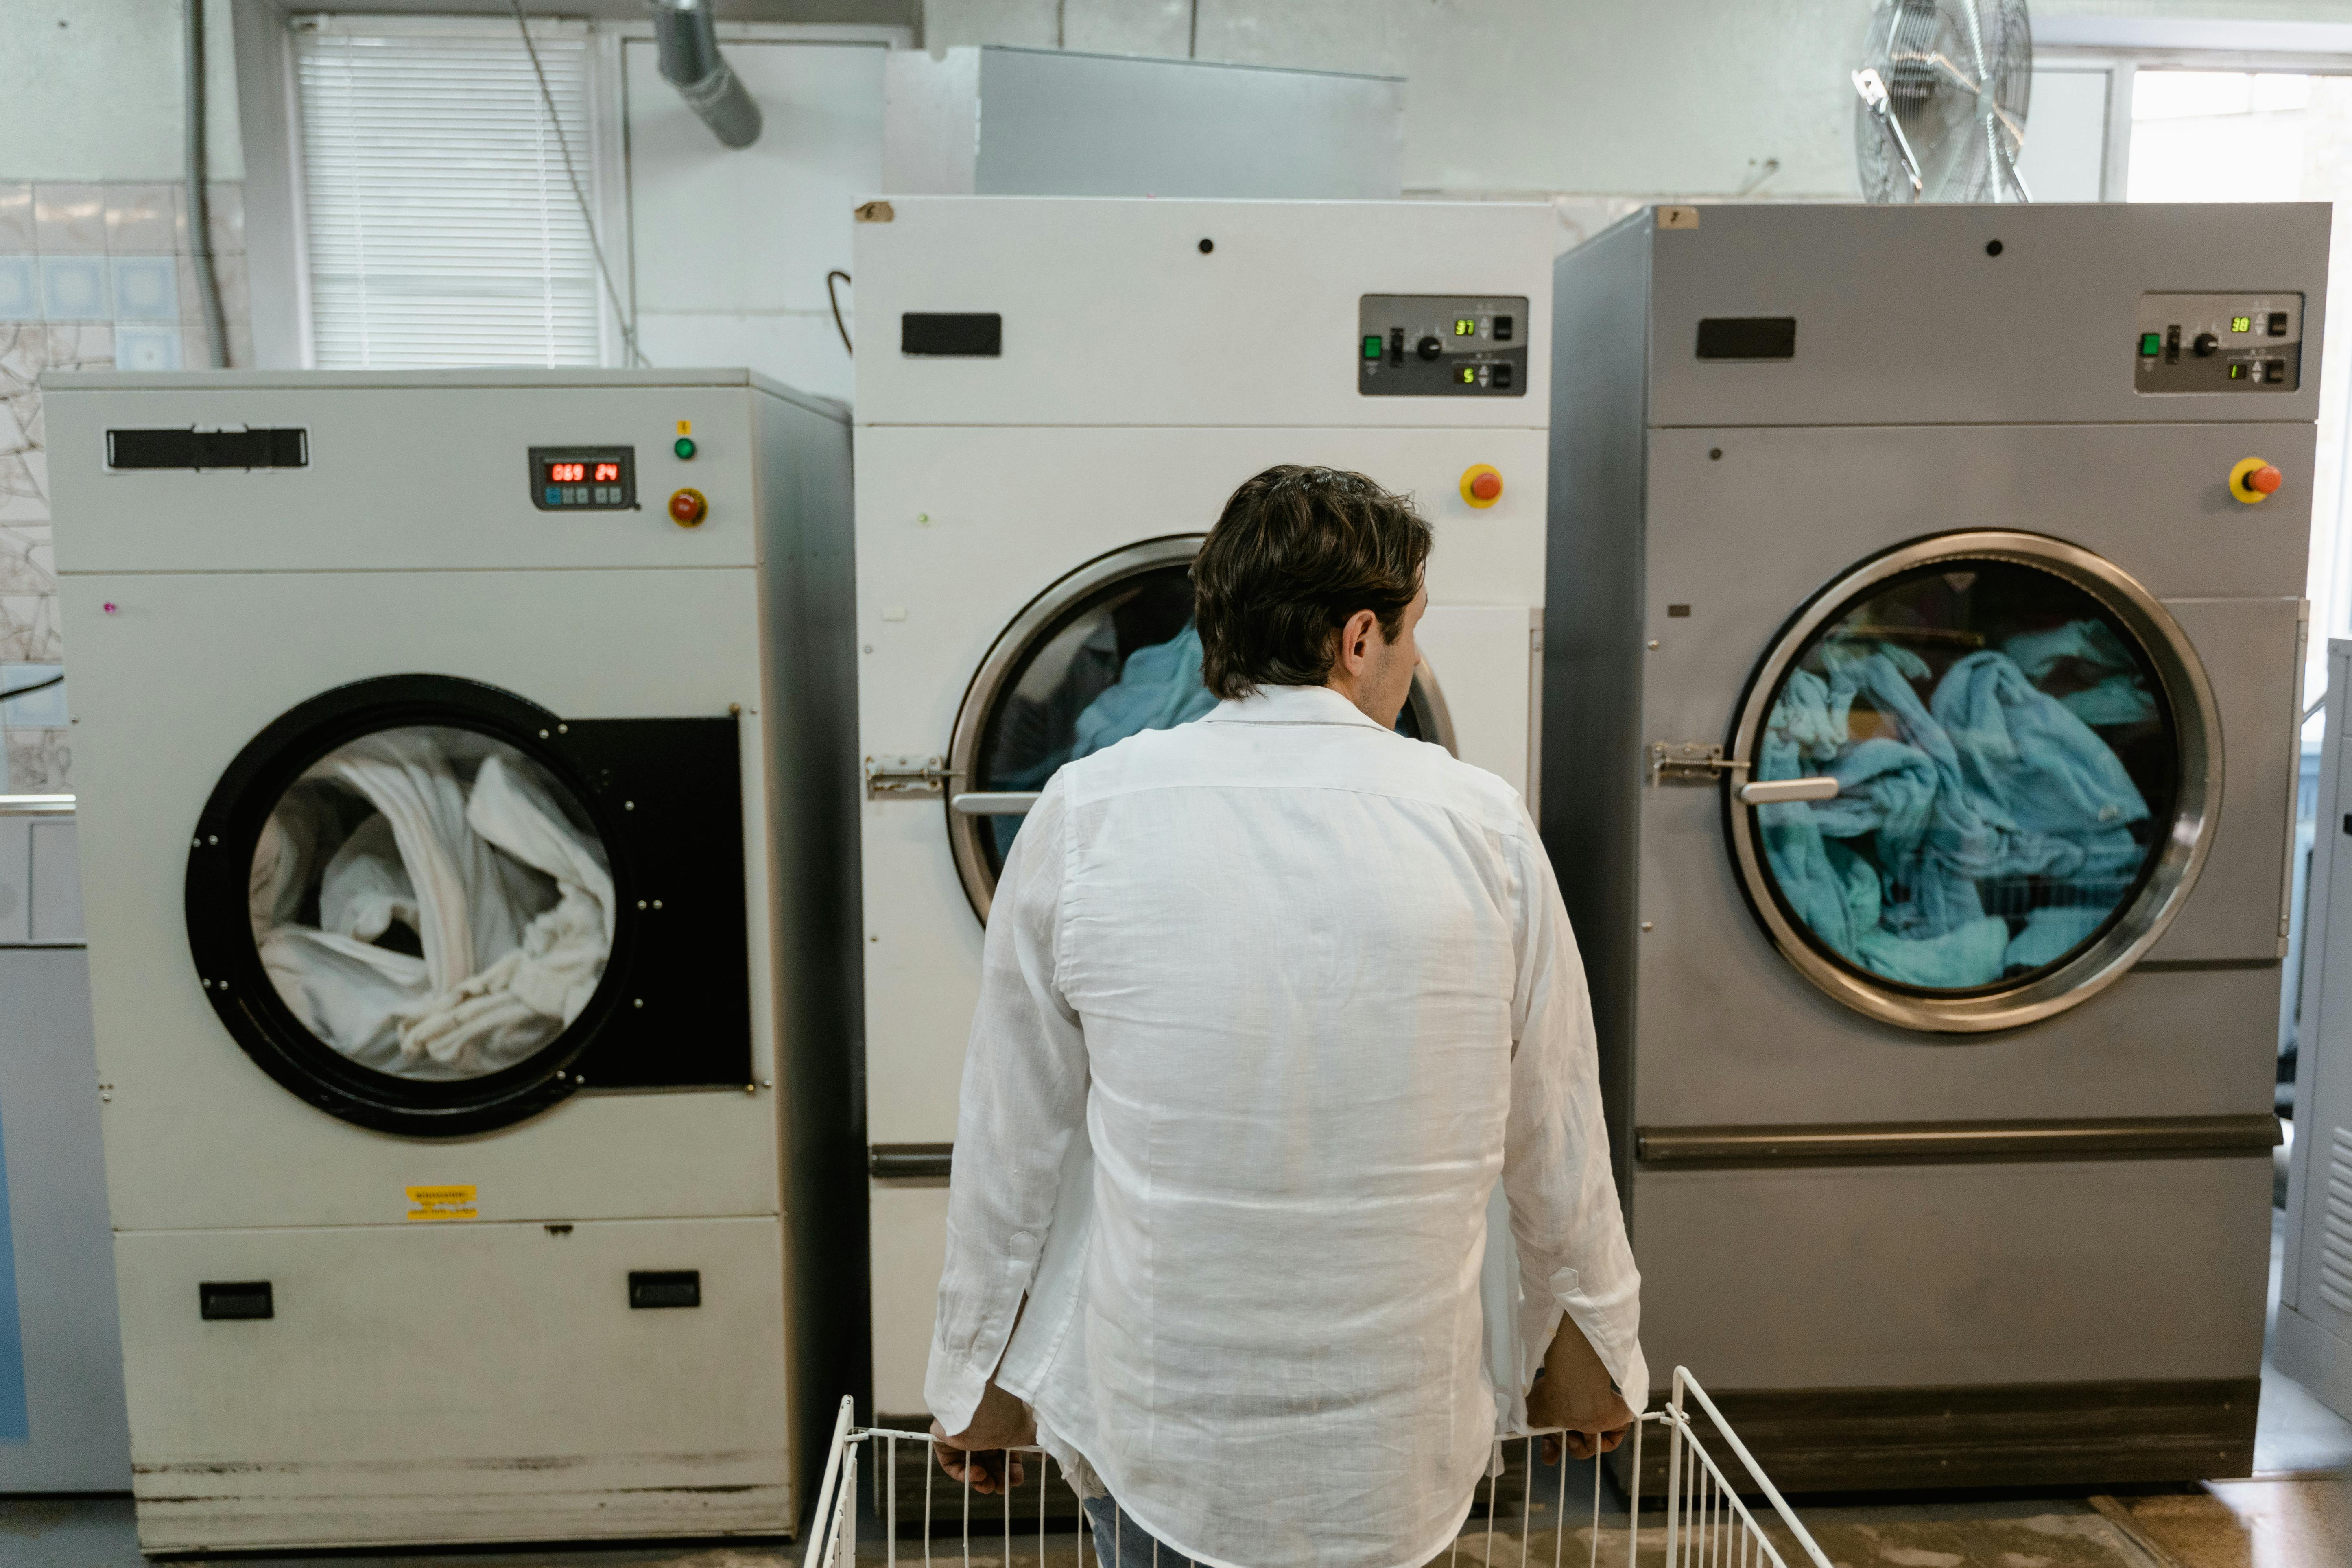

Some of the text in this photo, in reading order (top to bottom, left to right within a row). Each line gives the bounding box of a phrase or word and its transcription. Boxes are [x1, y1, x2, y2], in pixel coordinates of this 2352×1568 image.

[1456, 319, 1475, 335] 37
[2232, 317, 2251, 332] 38
[1464, 368, 1474, 384] 5
[595, 464, 618, 481] 24
